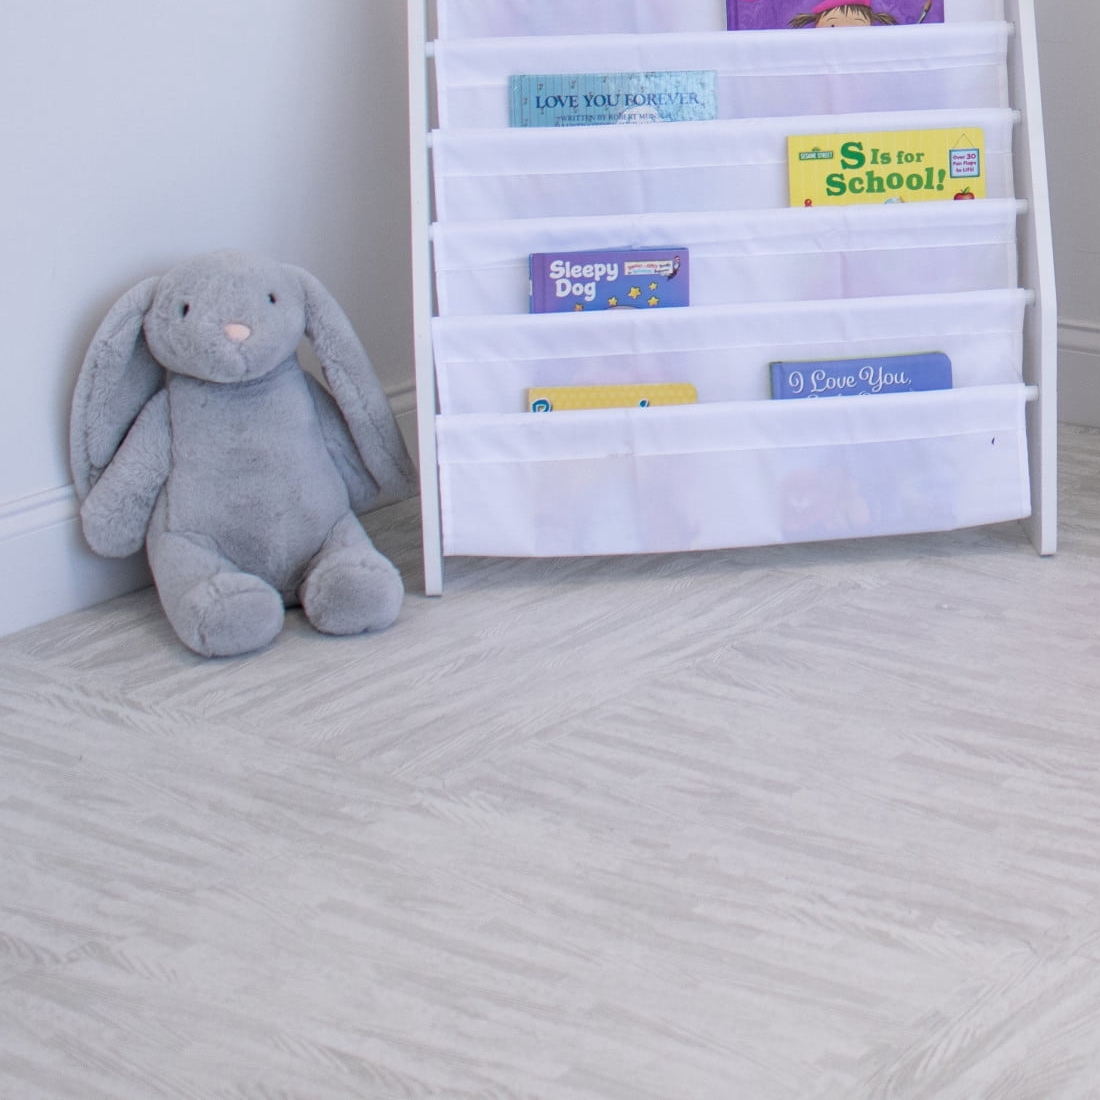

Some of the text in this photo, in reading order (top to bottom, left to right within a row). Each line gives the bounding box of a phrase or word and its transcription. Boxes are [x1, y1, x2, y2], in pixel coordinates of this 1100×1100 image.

[535, 92, 700, 109] LOVE YOU FOREVER
[840, 141, 925, 170] S Is for
[826, 167, 946, 197] School!
[550, 260, 618, 281] Sleepy
[555, 279, 596, 301] Dog
[788, 365, 912, 394] I Love You,
